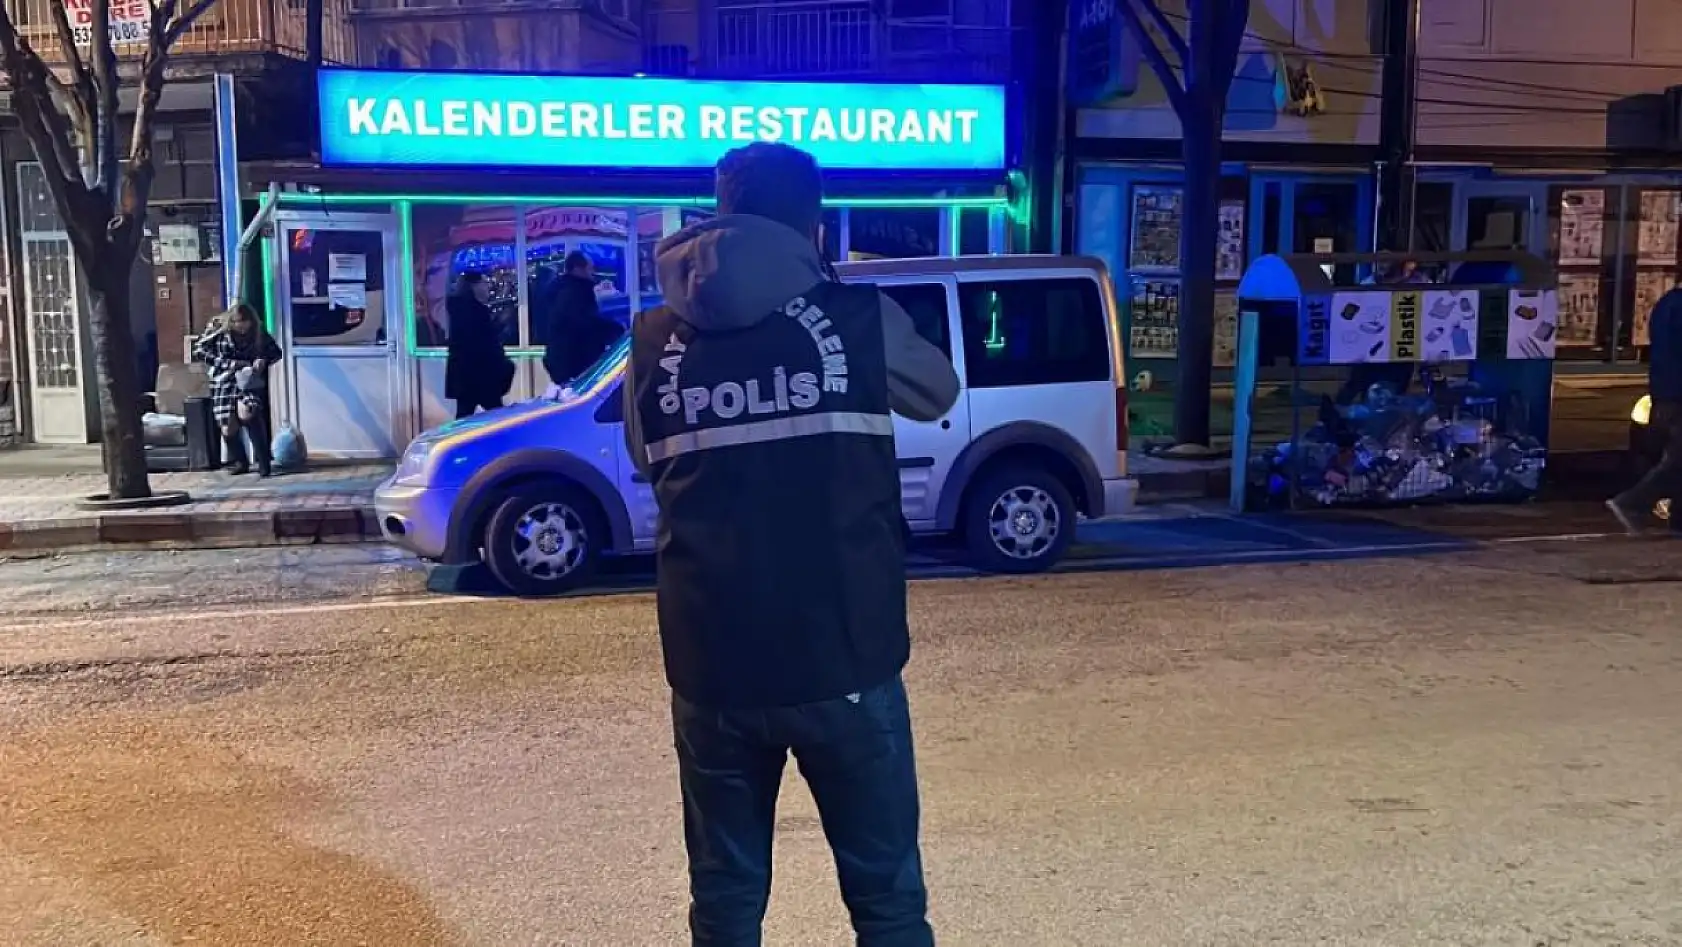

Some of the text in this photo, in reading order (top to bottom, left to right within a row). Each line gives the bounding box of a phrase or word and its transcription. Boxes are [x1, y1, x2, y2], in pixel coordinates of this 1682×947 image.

[348, 97, 978, 142] KALENDERLER RESTAURANT
[778, 297, 848, 393] CELEME
[1397, 295, 1416, 358] Plastik
[681, 365, 820, 424] POLİS
